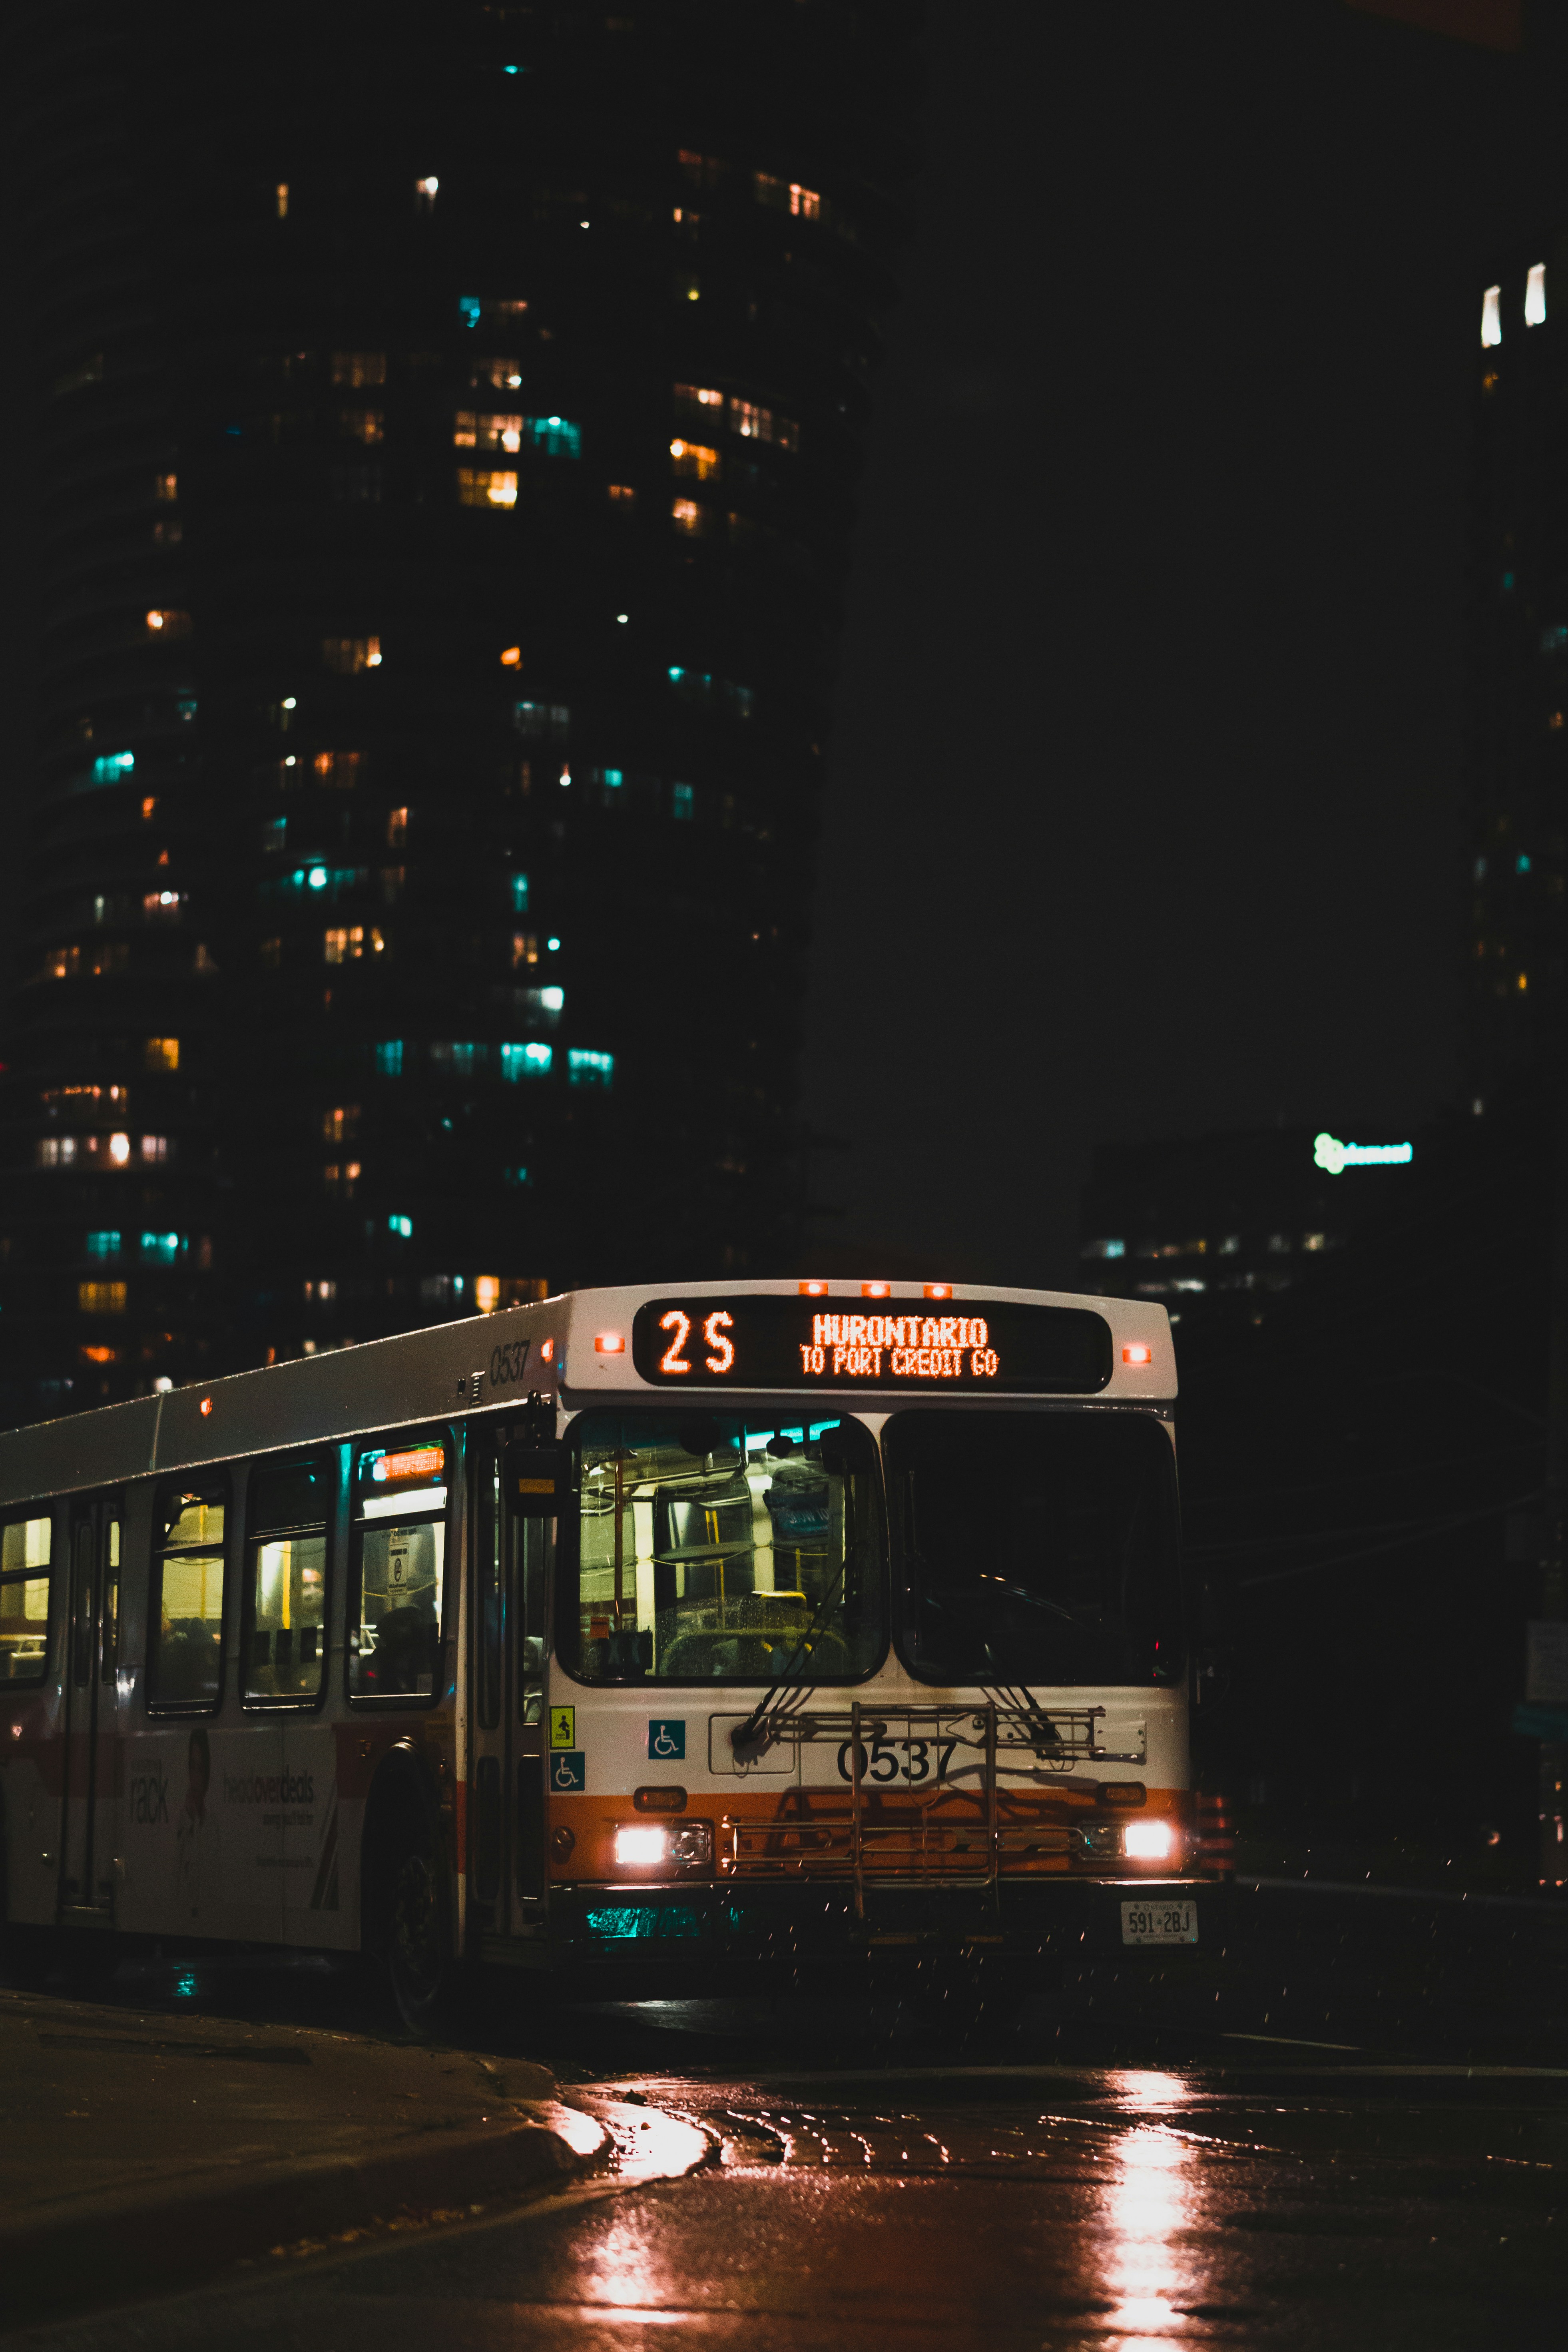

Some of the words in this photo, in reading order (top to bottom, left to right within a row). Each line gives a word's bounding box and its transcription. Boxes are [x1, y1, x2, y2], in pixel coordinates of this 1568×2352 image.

[813, 1314, 988, 1347] HURONTARIO
[490, 1339, 531, 1386] 0537
[800, 1345, 825, 1375] TO
[833, 1347, 882, 1376] PORT
[891, 1347, 963, 1377] CREDIT
[970, 1348, 1000, 1376] GO
[837, 1740, 956, 1782] 0537
[1129, 1912, 1154, 1933] 591
[1164, 1911, 1190, 1932] 2BJ
